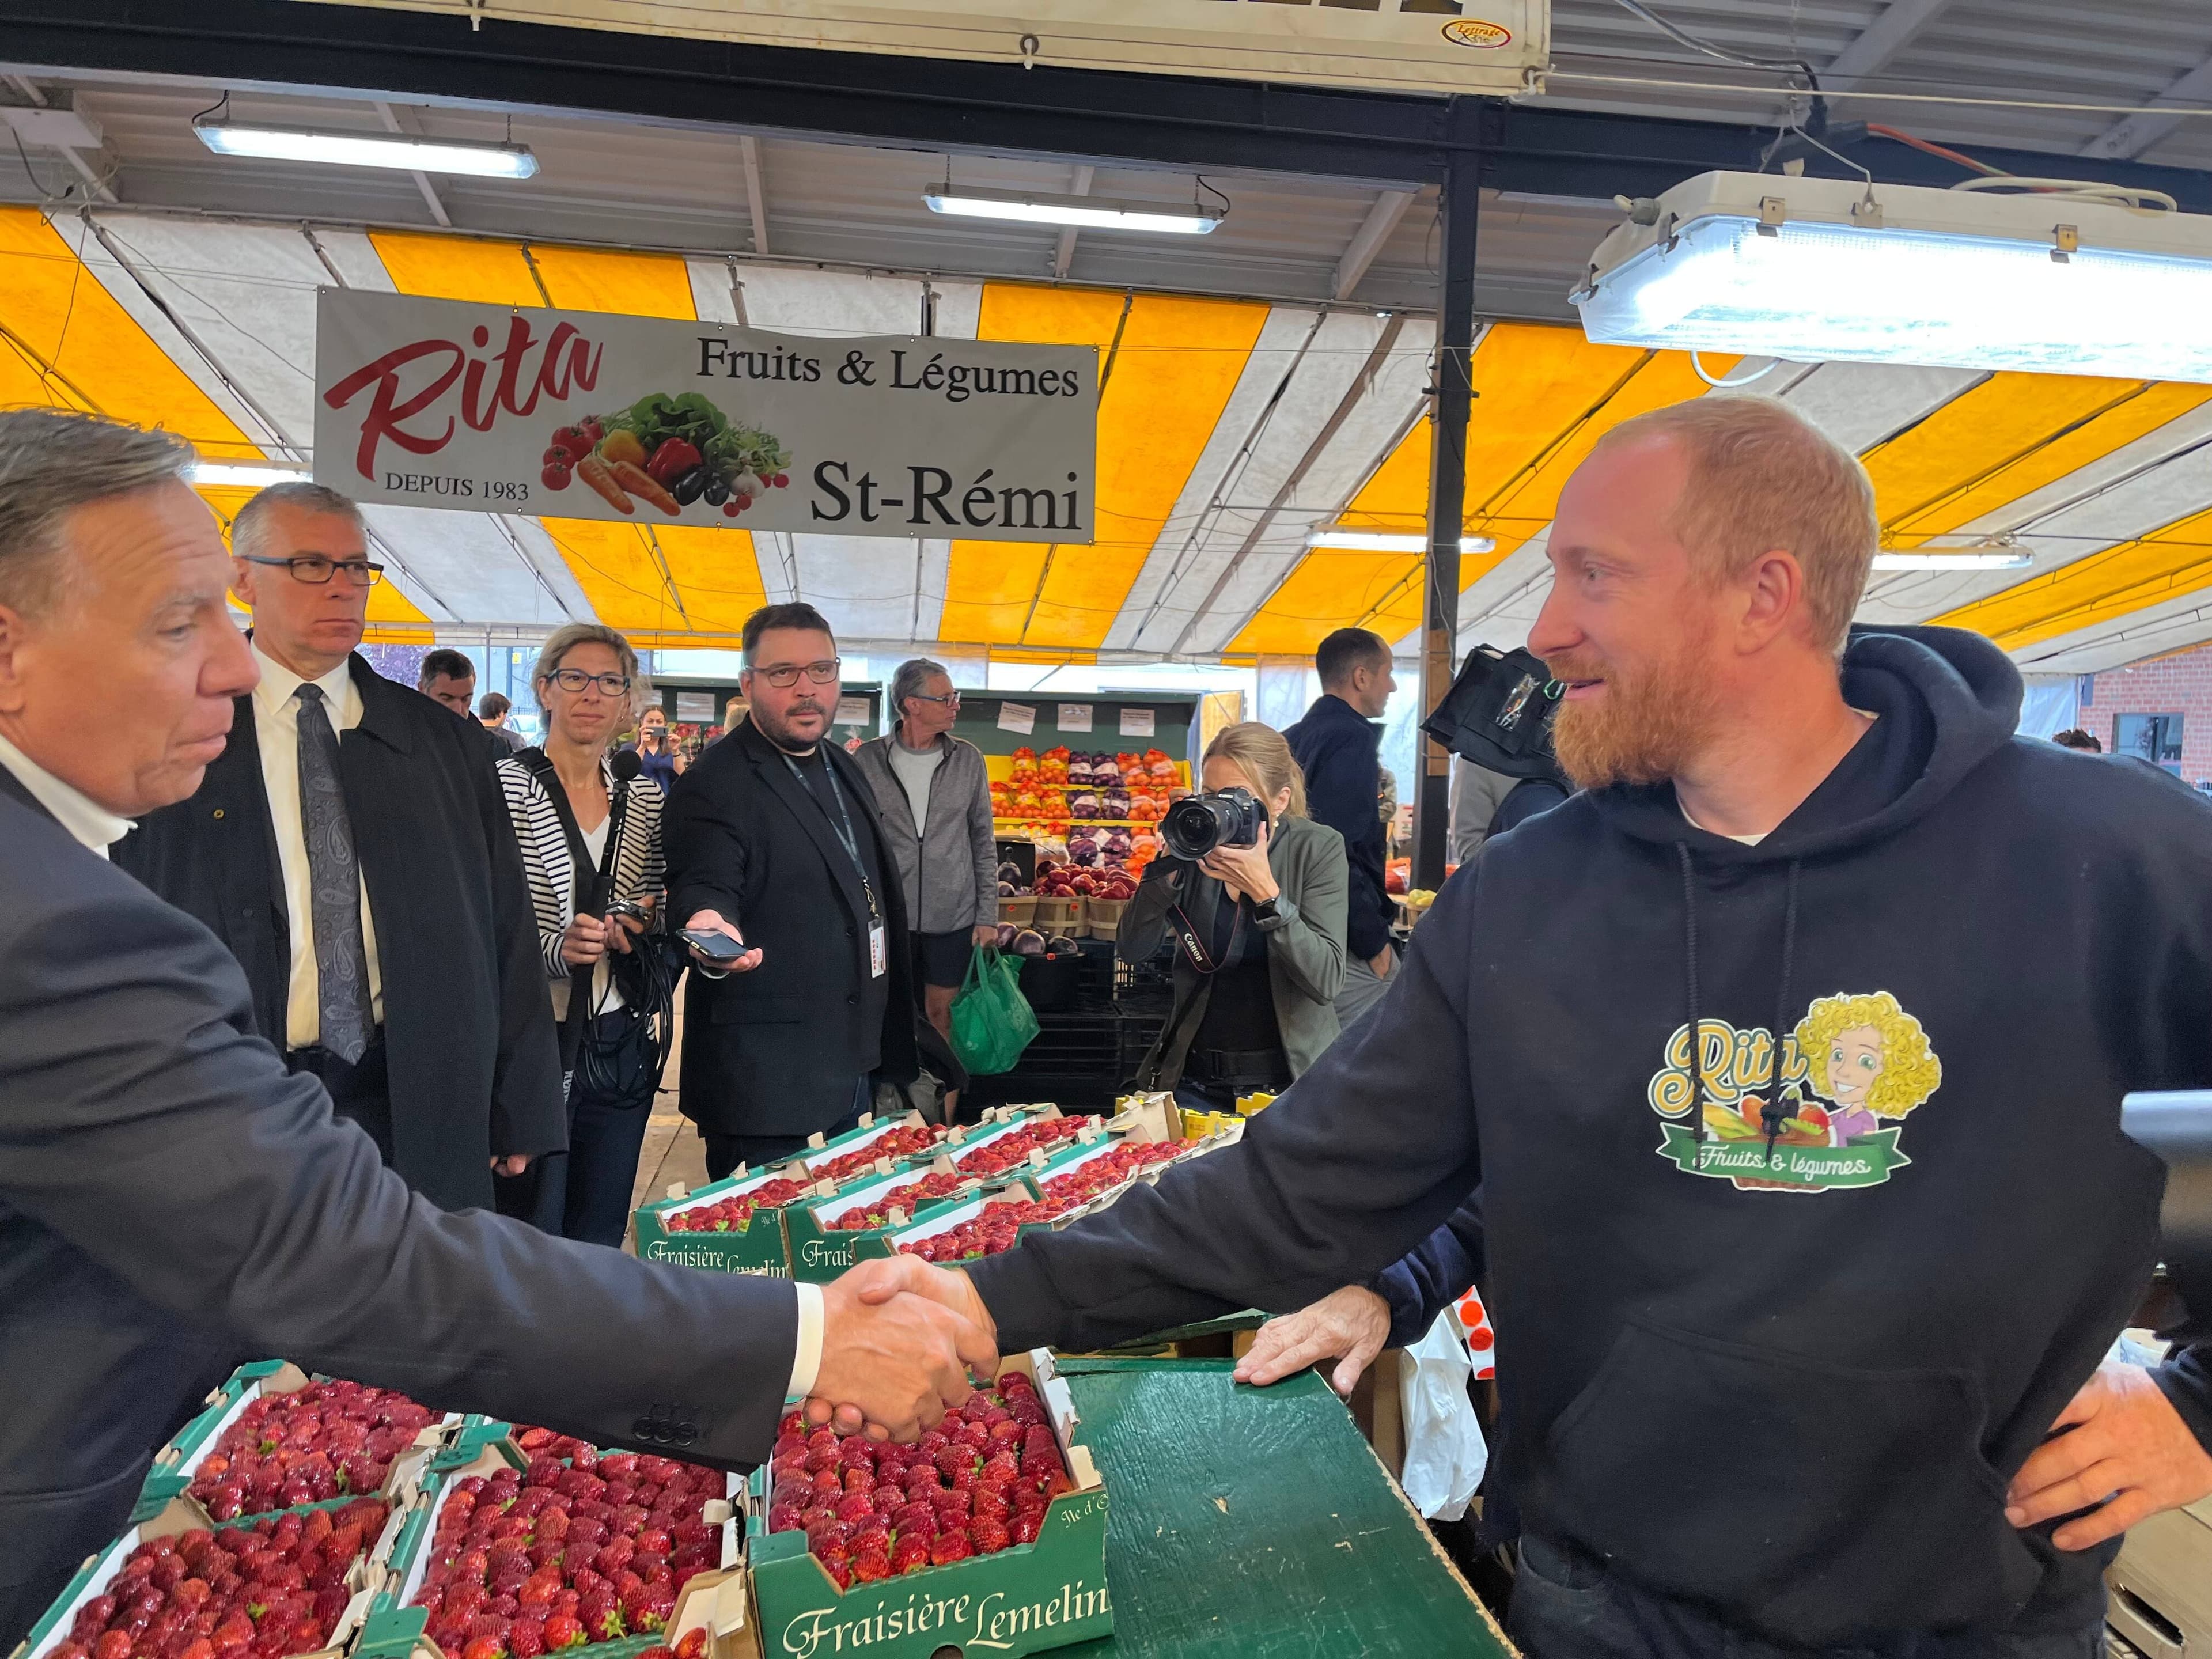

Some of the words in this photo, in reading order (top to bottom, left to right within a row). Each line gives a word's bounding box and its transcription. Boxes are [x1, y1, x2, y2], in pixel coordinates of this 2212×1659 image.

[1457, 24, 1501, 37] Lettrage
[697, 336, 821, 383] Fruits
[838, 350, 877, 388] &
[889, 349, 1080, 402] Légumes
[323, 315, 603, 483] Rita
[384, 471, 475, 498] DEPUIS
[482, 480, 530, 502] 1983
[812, 460, 1083, 532] St-Rémi
[1184, 933, 1203, 962] Canon
[1653, 1022, 1808, 1115] Rita
[1692, 1145, 1766, 1170] Fruits
[1771, 1154, 1785, 1171] &
[1790, 1152, 1872, 1181] légumes
[647, 1240, 724, 1267] Fraisière
[782, 1594, 970, 1659] Fraisière
[966, 1580, 1112, 1650] Lemelin
